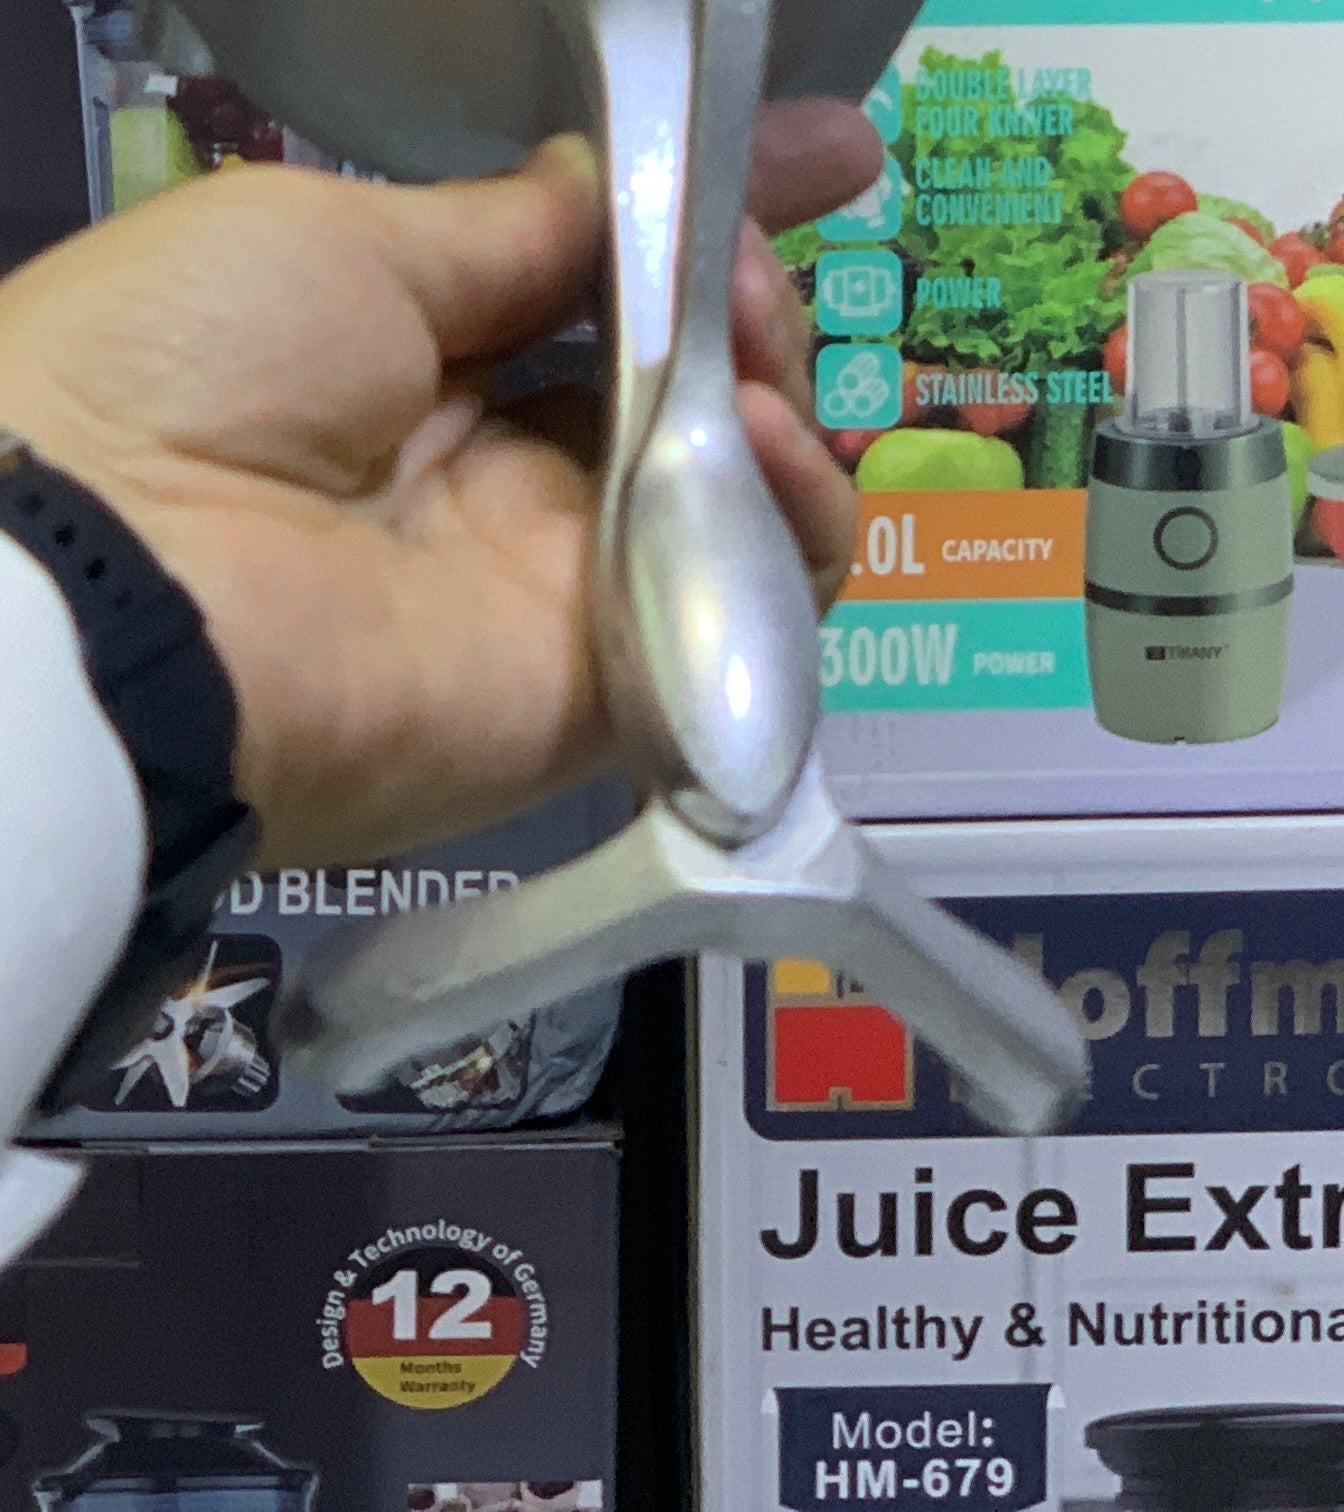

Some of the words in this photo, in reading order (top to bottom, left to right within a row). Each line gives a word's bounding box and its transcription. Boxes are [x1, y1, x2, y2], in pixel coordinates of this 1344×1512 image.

[915, 67, 1011, 102] DOUBLE
[1017, 66, 1093, 102] LAYER
[915, 104, 981, 138] FOUR
[915, 157, 993, 190] CLEAN
[1000, 156, 1054, 189] AND
[915, 276, 1003, 310] POWER
[915, 372, 1040, 406] STAINLESS
[1046, 371, 1115, 405] STEEL
[942, 538, 1053, 563] CAPACITY
[973, 651, 1055, 675] POWER
[759, 1166, 1080, 1261] Juice
[315, 1288, 347, 1370] Design
[332, 1268, 357, 1289] &
[346, 1218, 493, 1269] Technology
[491, 1244, 525, 1267] of
[513, 1262, 550, 1370] Germany
[371, 1268, 493, 1341] 12
[760, 1305, 984, 1362] Healthy
[1003, 1303, 1047, 1349] &
[832, 1410, 996, 1452] Model:
[813, 1458, 1017, 1501] HM-679
